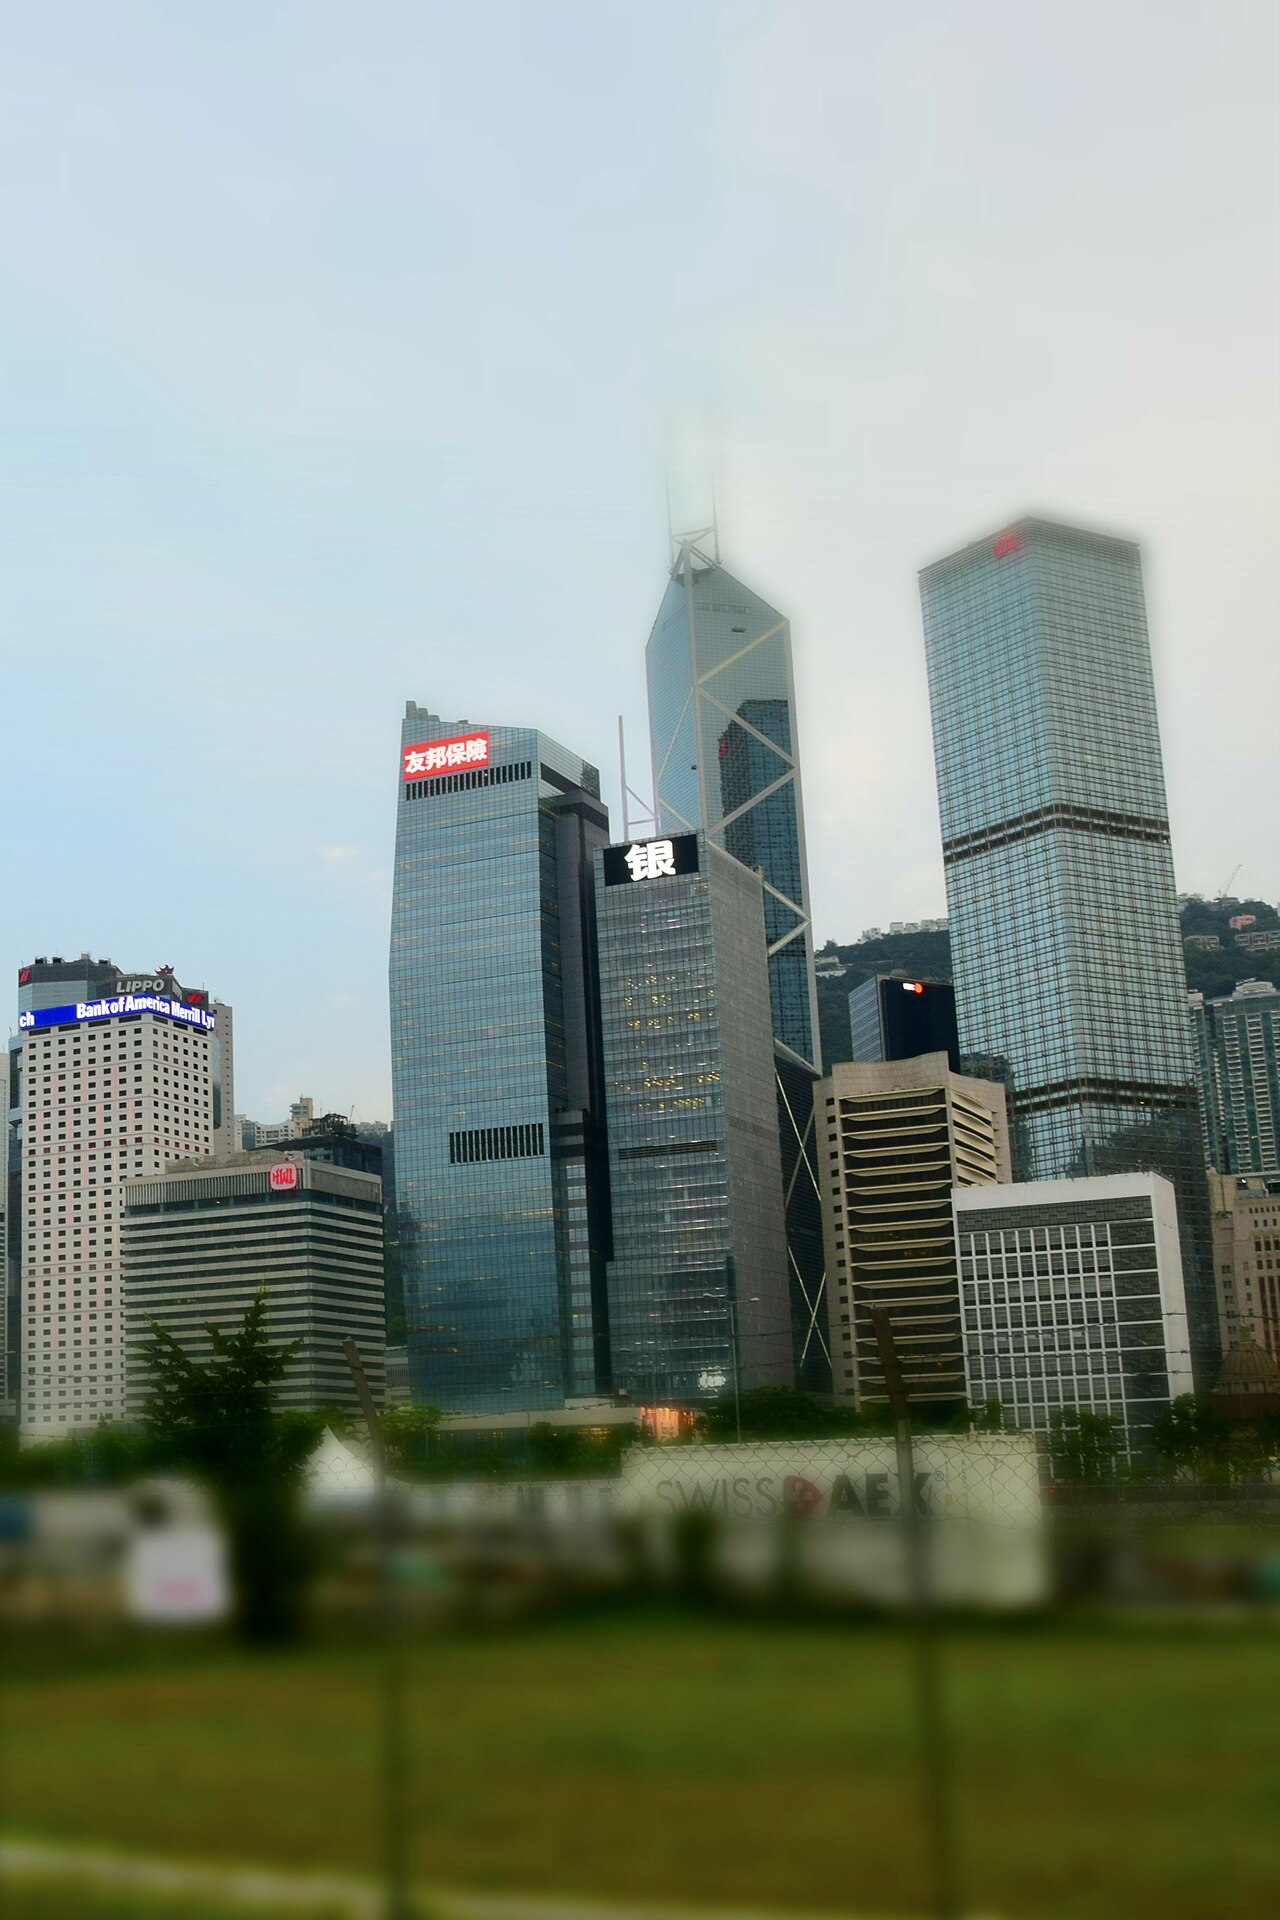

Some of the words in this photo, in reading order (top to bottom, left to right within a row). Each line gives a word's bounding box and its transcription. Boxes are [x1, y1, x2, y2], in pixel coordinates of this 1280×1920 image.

[404, 738, 488, 774] 友邦保險
[624, 839, 677, 882] 银
[116, 979, 165, 993] LIPPO
[76, 1000, 111, 1019] Bank
[110, 995, 125, 1014] of
[124, 995, 170, 1015] America
[171, 1000, 201, 1024] Merrill
